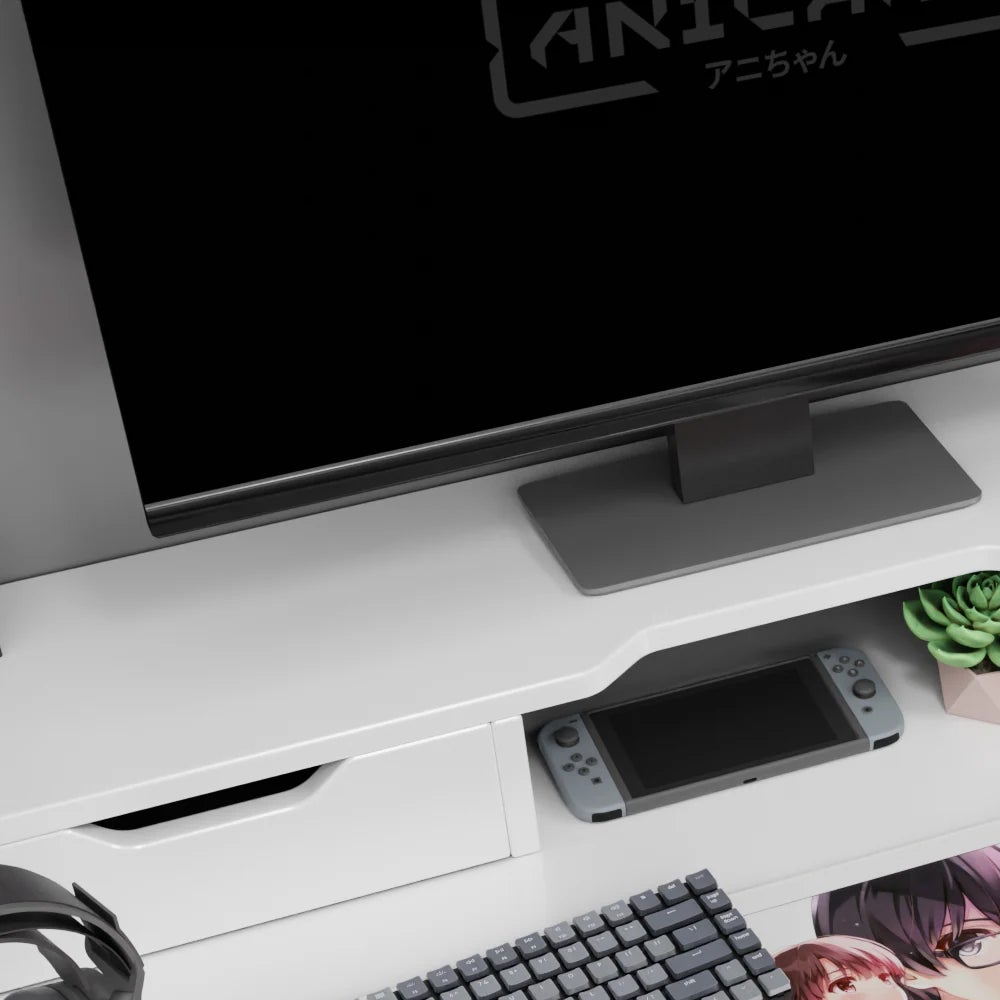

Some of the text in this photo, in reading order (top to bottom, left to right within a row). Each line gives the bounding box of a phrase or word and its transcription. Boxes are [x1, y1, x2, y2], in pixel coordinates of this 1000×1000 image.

[705, 40, 848, 90] アニちゃん
[734, 931, 750, 941] home
[751, 952, 763, 960] end
[683, 978, 697, 987] shift
